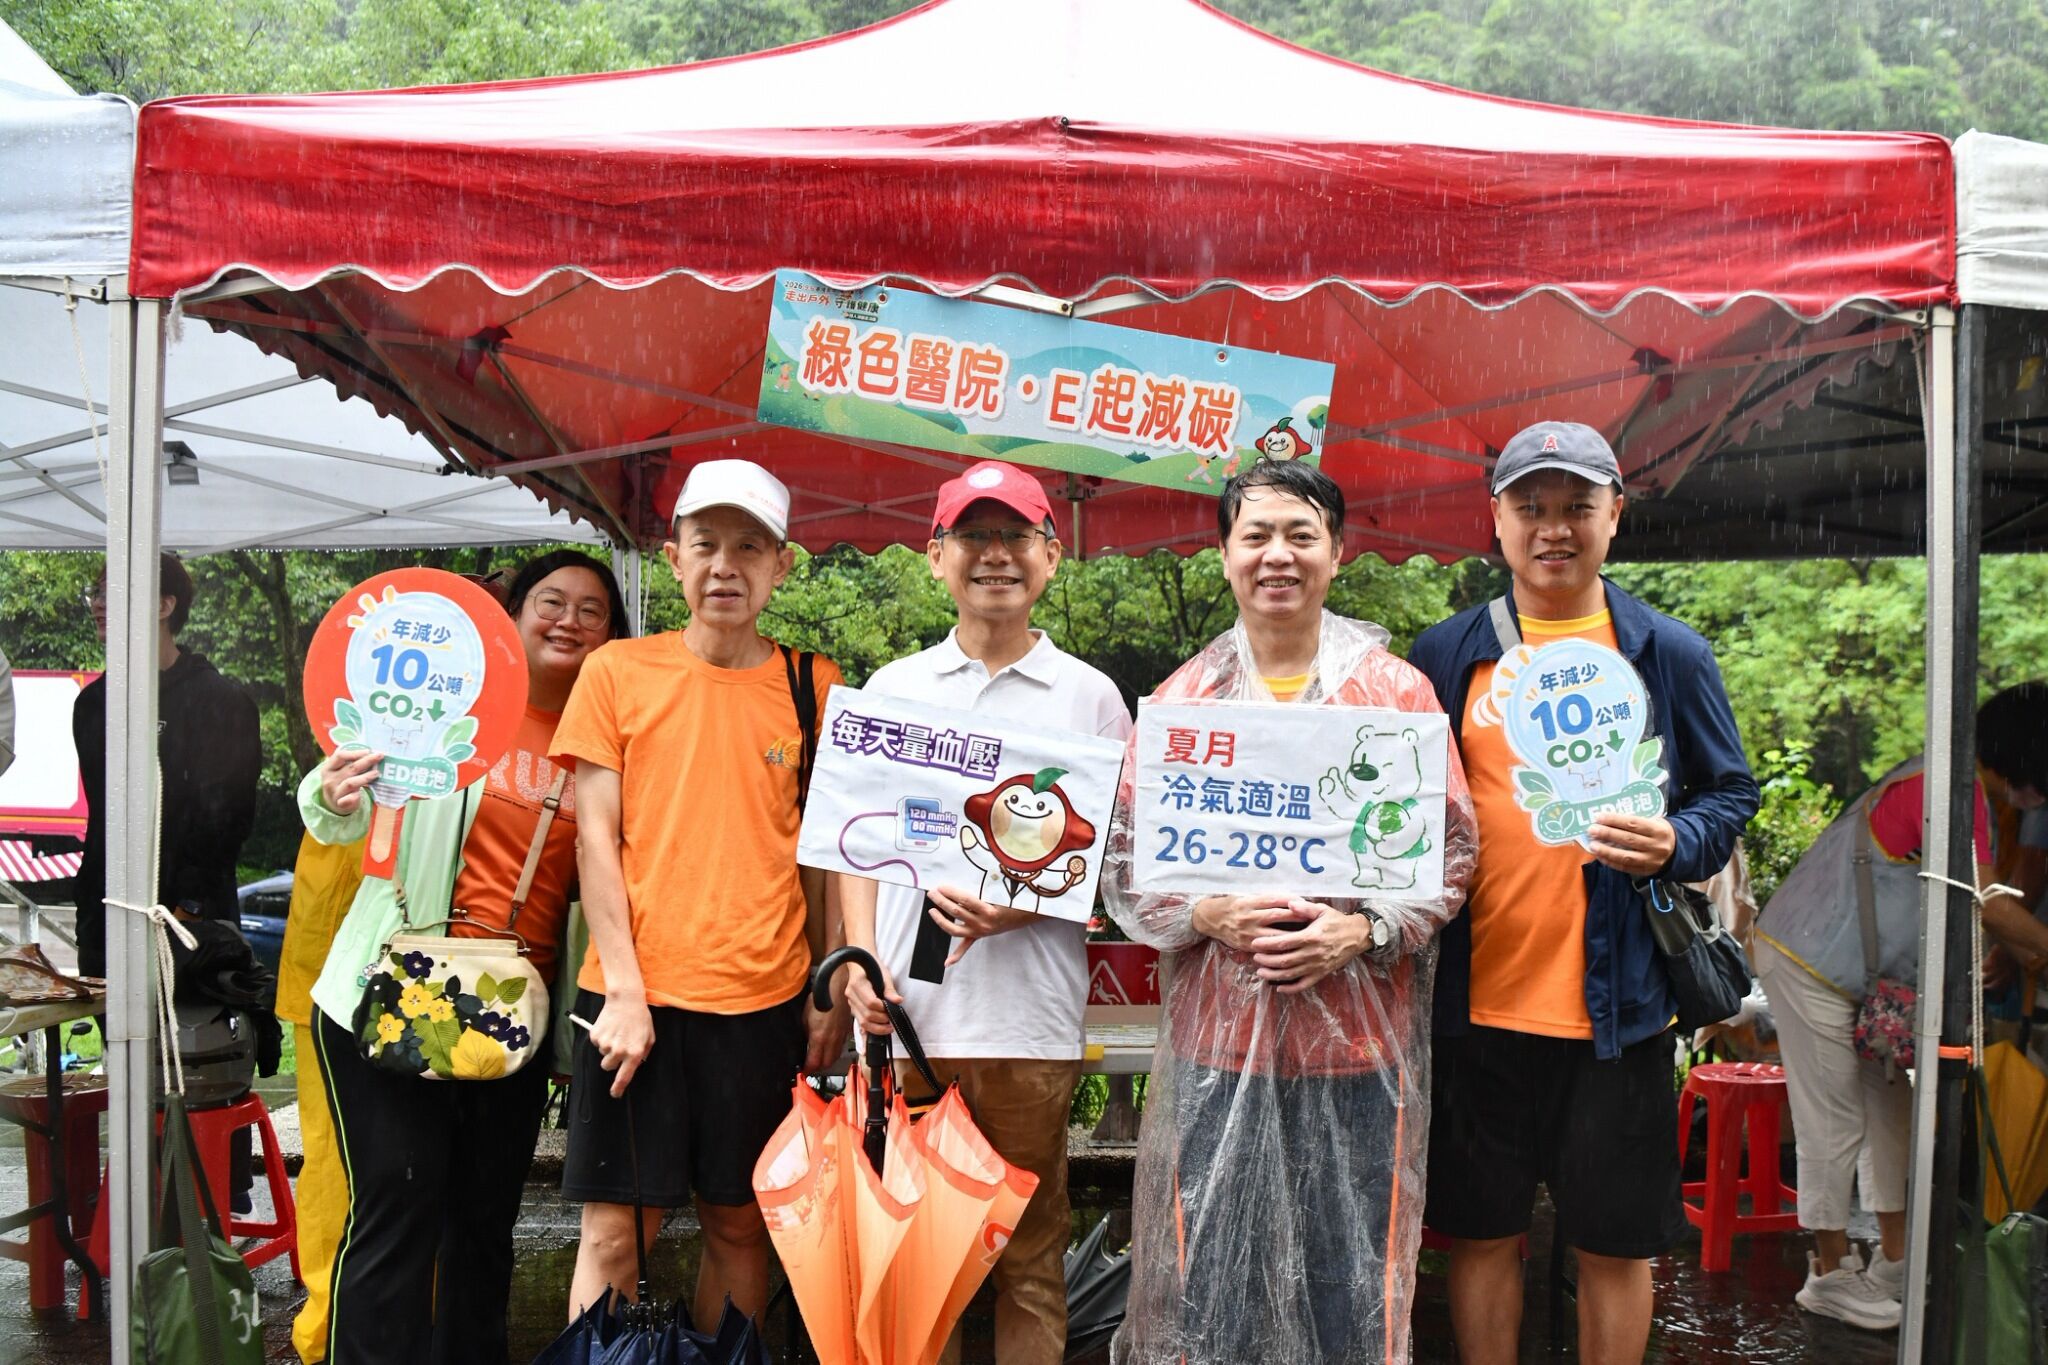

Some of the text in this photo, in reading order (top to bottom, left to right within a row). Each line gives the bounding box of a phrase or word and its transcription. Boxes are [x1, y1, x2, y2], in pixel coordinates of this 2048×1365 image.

[1541, 434, 1559, 452] A
[391, 618, 452, 645] 年減少
[1538, 662, 1599, 692] 年減少
[832, 710, 1002, 781] 每天量血壓
[1163, 727, 1236, 768] 夏月
[1159, 773, 1312, 820] 冷氣適溫
[909, 807, 958, 827] 120 mmHg
[911, 820, 957, 839] 80 mmHg
